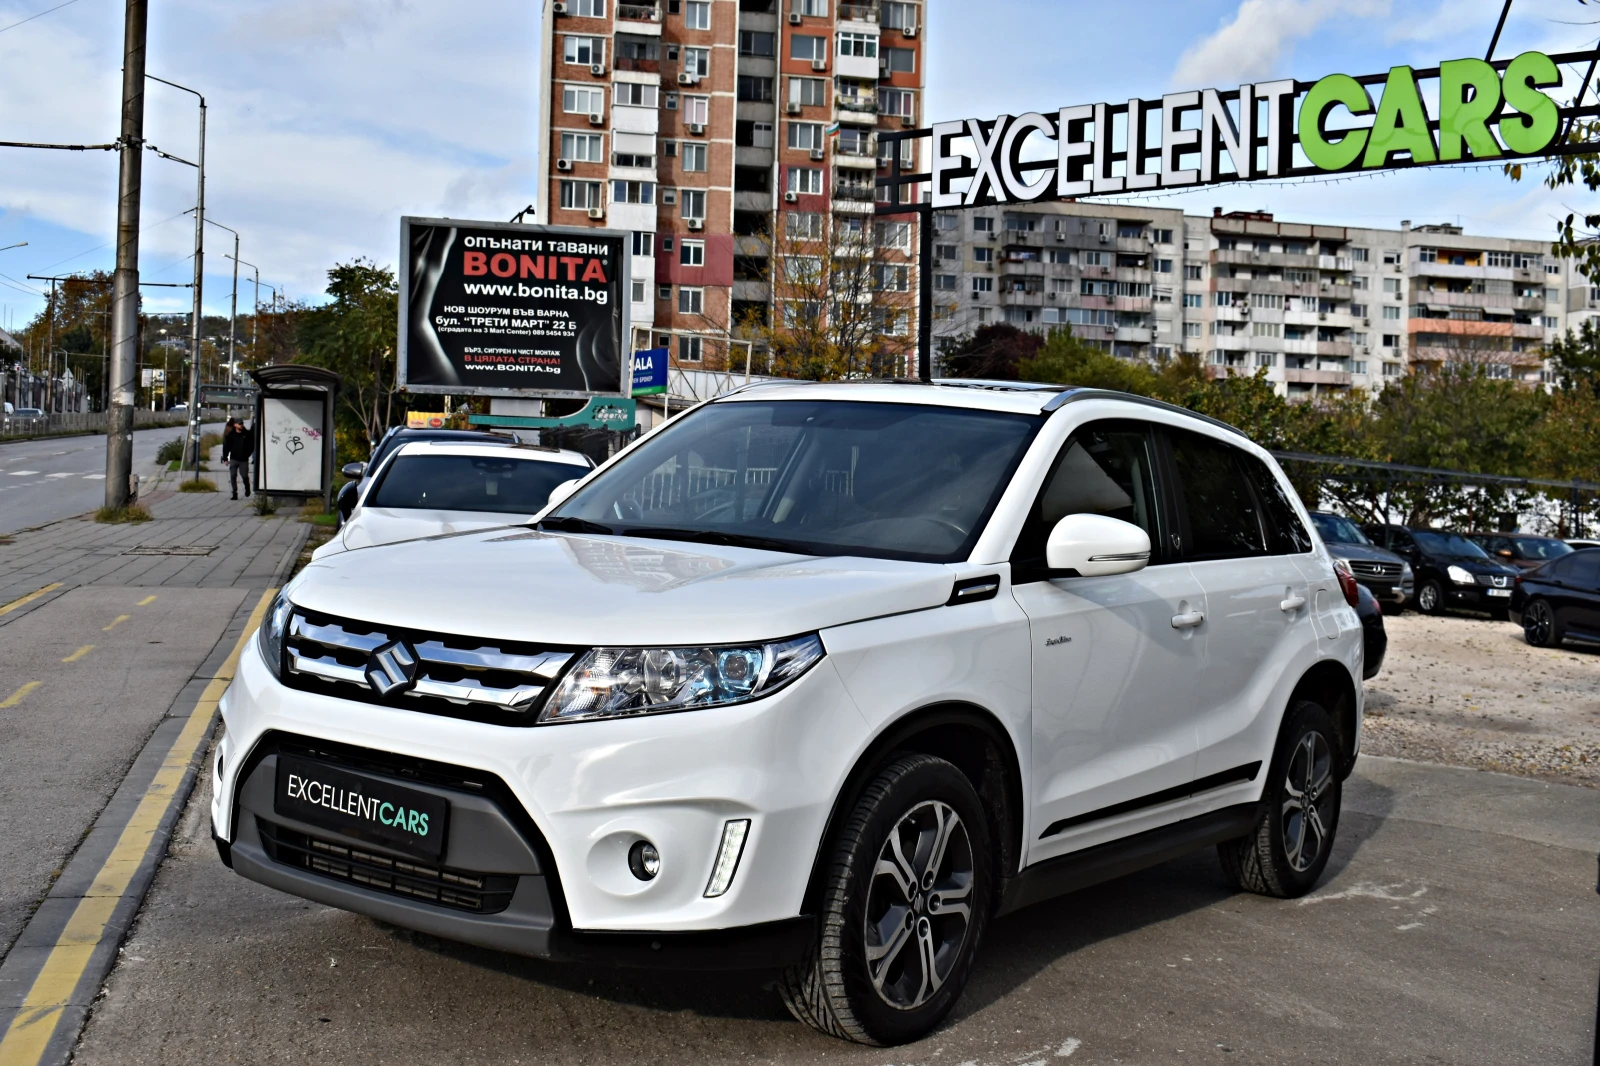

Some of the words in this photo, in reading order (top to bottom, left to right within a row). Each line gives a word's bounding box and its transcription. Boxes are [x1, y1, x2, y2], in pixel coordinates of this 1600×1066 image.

[464, 236, 542, 250] опънати
[547, 240, 608, 255] тавани
[464, 283, 608, 304] www.bonita.bg
[444, 305, 465, 313] НОВ
[467, 306, 510, 315] ШОУРУМ
[512, 308, 534, 316] ВЪВ
[537, 309, 569, 318] ВАРНА
[435, 315, 460, 326] бул.
[552, 321, 565, 329] 22
[568, 321, 577, 330] Б
[474, 355, 515, 363] ЦЯЛАТА
[517, 357, 561, 365] СТРАНА!
[464, 364, 561, 374] www.BONITA.bg
